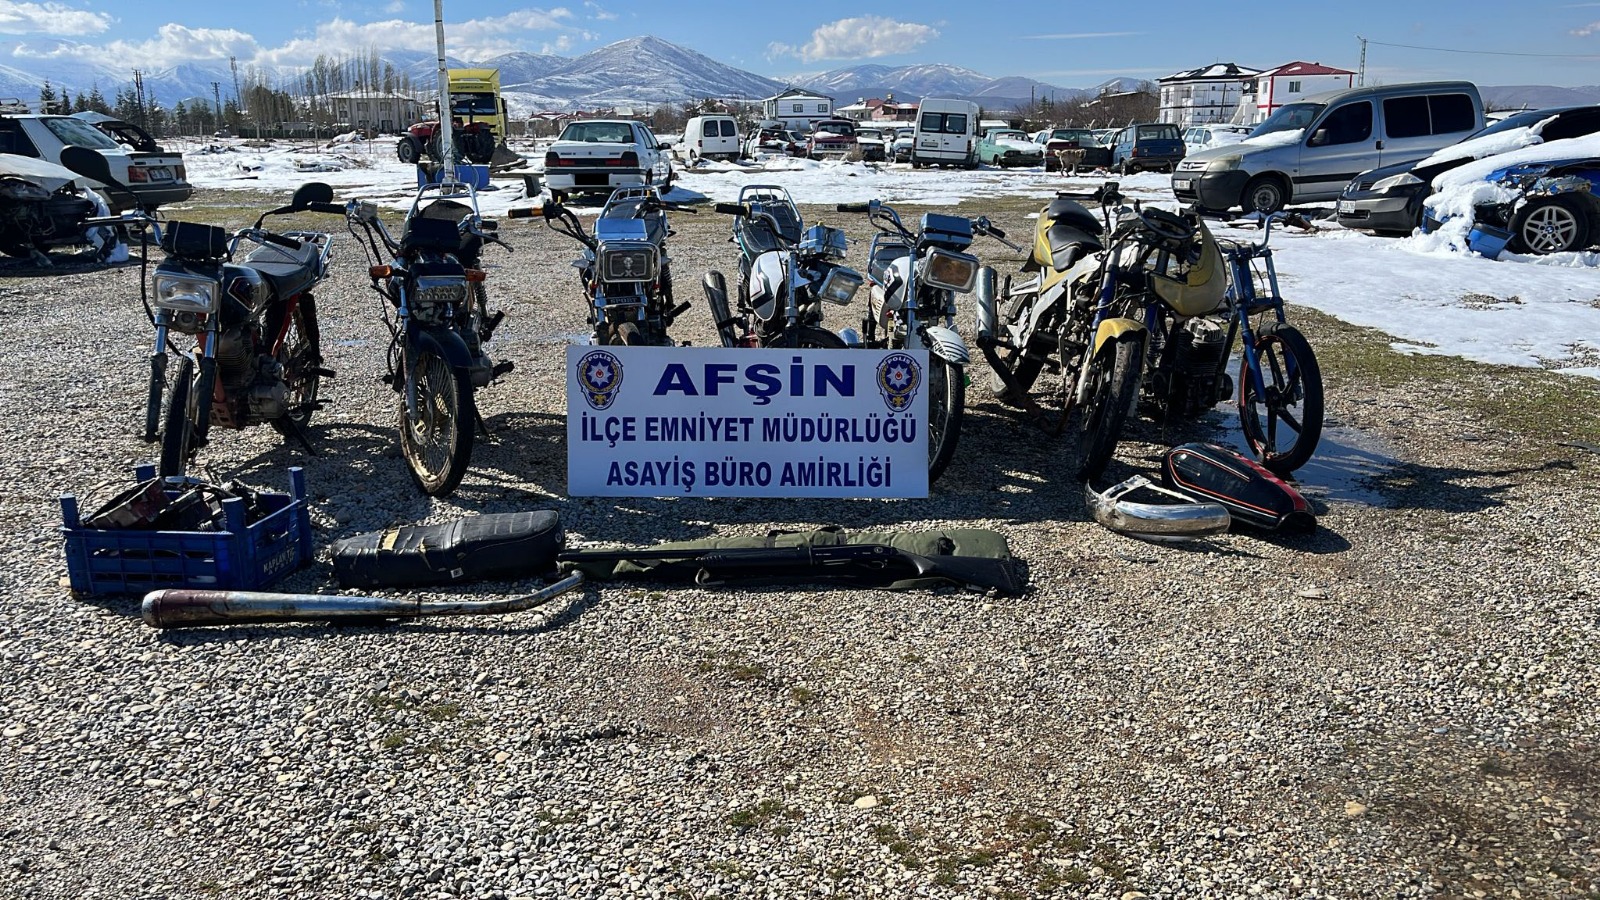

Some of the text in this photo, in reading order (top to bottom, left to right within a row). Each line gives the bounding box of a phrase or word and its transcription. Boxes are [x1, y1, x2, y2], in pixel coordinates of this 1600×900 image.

[653, 356, 856, 406] AFŞİN
[581, 410, 917, 449] İLÇE EMNİYET MÜDÜRLÜĞÜ
[606, 454, 892, 494] ASAYİŞ BÜRO AMİRLİĞİ
